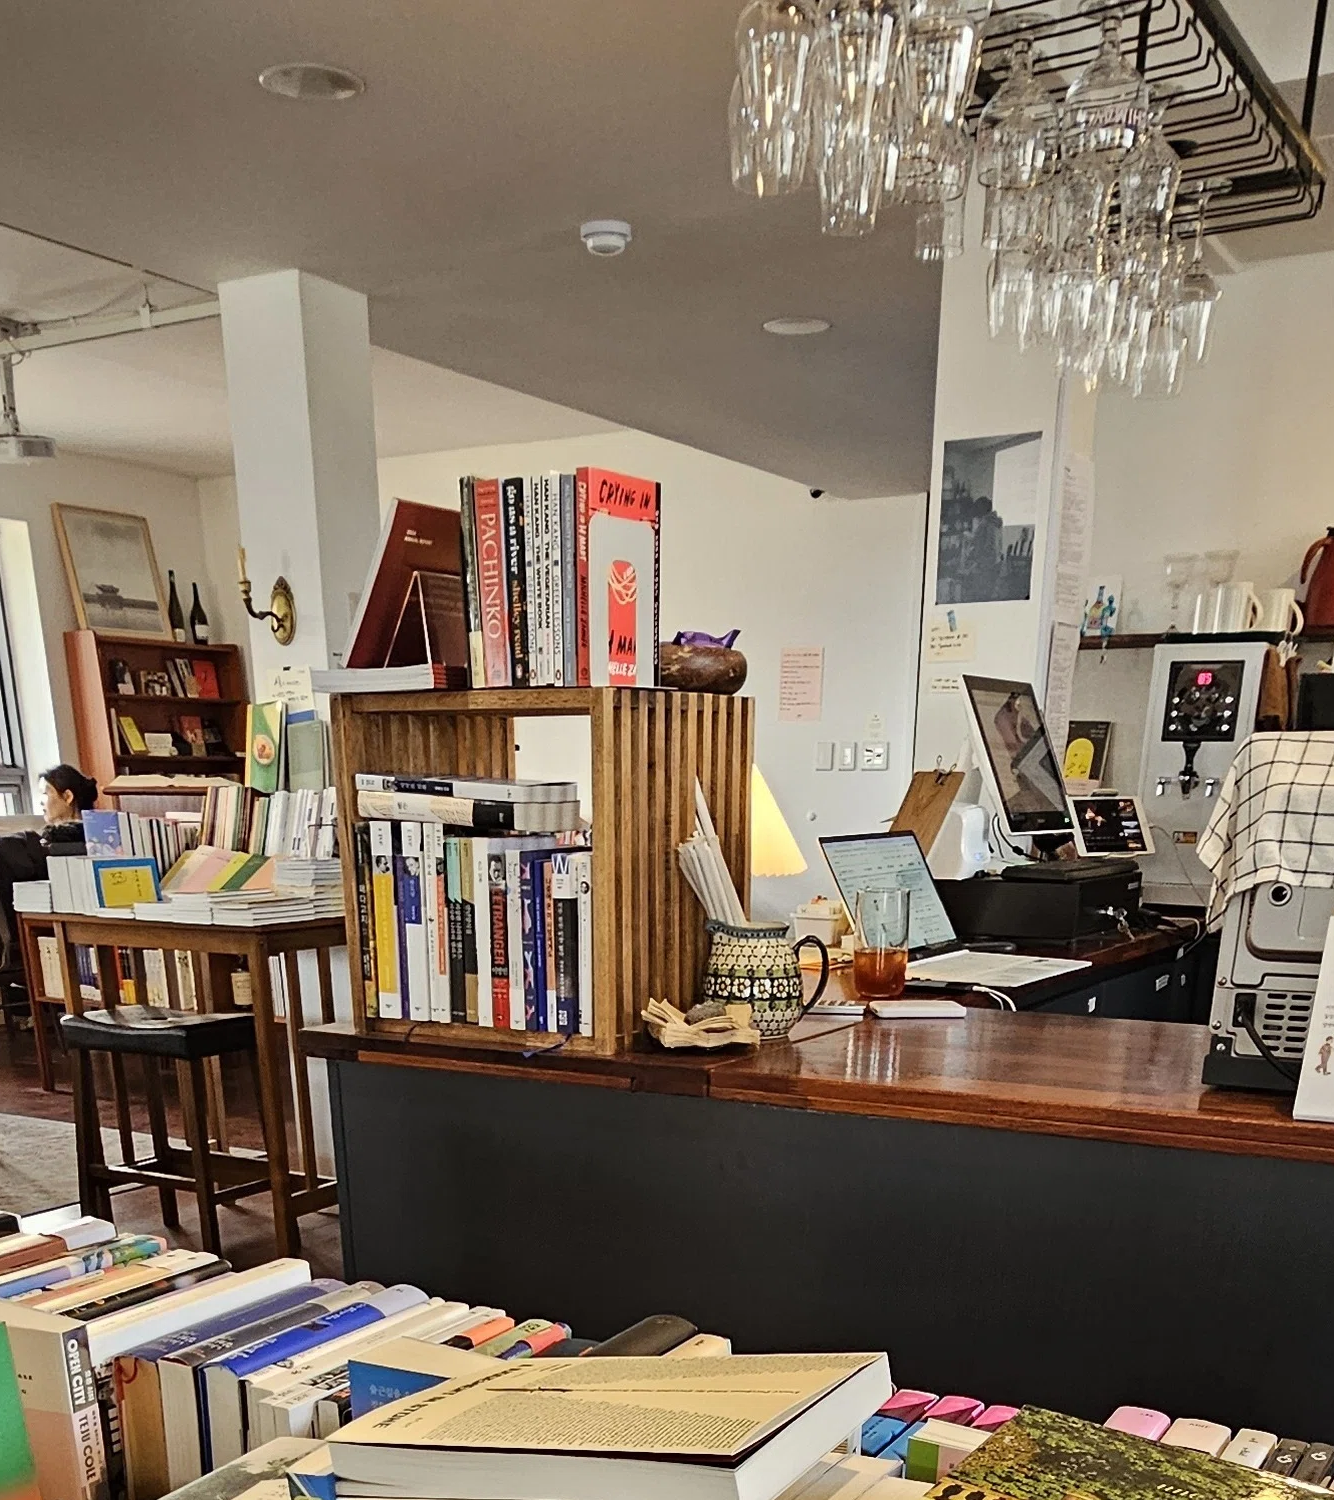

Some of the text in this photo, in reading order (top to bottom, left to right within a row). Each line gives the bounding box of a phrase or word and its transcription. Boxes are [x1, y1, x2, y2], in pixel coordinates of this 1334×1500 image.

[599, 479, 651, 511] CRYING IN
[480, 513, 502, 639] PACHINKO
[66, 1339, 87, 1406] OPEN CITY
[78, 1414, 98, 1482] TEJU COLE
